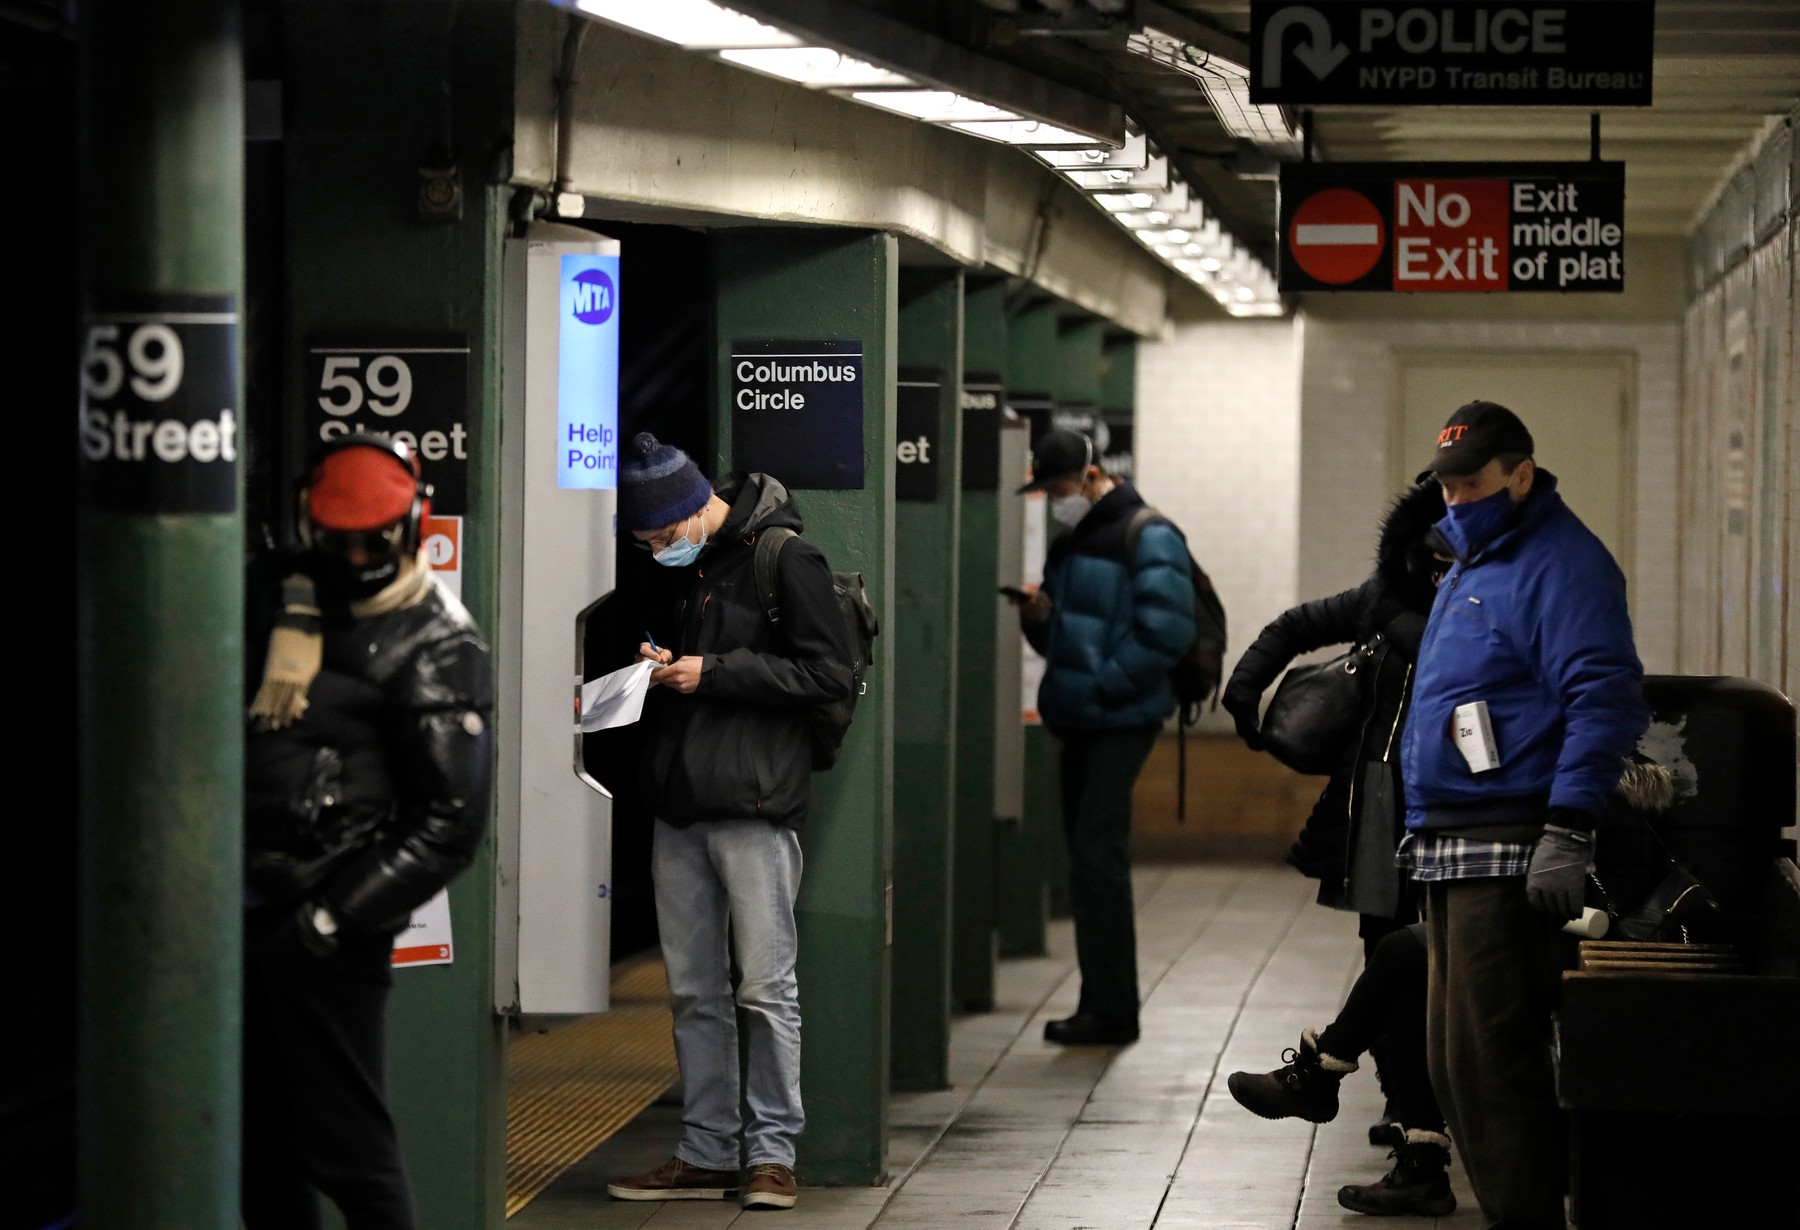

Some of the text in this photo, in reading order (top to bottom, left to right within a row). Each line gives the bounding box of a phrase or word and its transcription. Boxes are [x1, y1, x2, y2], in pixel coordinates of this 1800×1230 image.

[1359, 8, 1567, 54] POLICE
[1359, 67, 1644, 90] NYPD Transit Bureau
[1398, 183, 1472, 228] No
[1512, 183, 1579, 213] Exit
[1512, 216, 1622, 247] middle
[1398, 236, 1500, 281] Exit
[1512, 250, 1622, 287] of plat
[573, 281, 611, 314] MTA
[80, 324, 184, 401] 59
[736, 360, 857, 383] Columbus
[317, 355, 413, 418] 59
[736, 388, 806, 411] Circle
[83, 408, 237, 462] Street
[318, 419, 468, 462] Seet
[568, 423, 613, 447] Help
[568, 450, 615, 469] Point
[433, 541, 442, 559] 1
[1460, 727, 1473, 738] Zio
